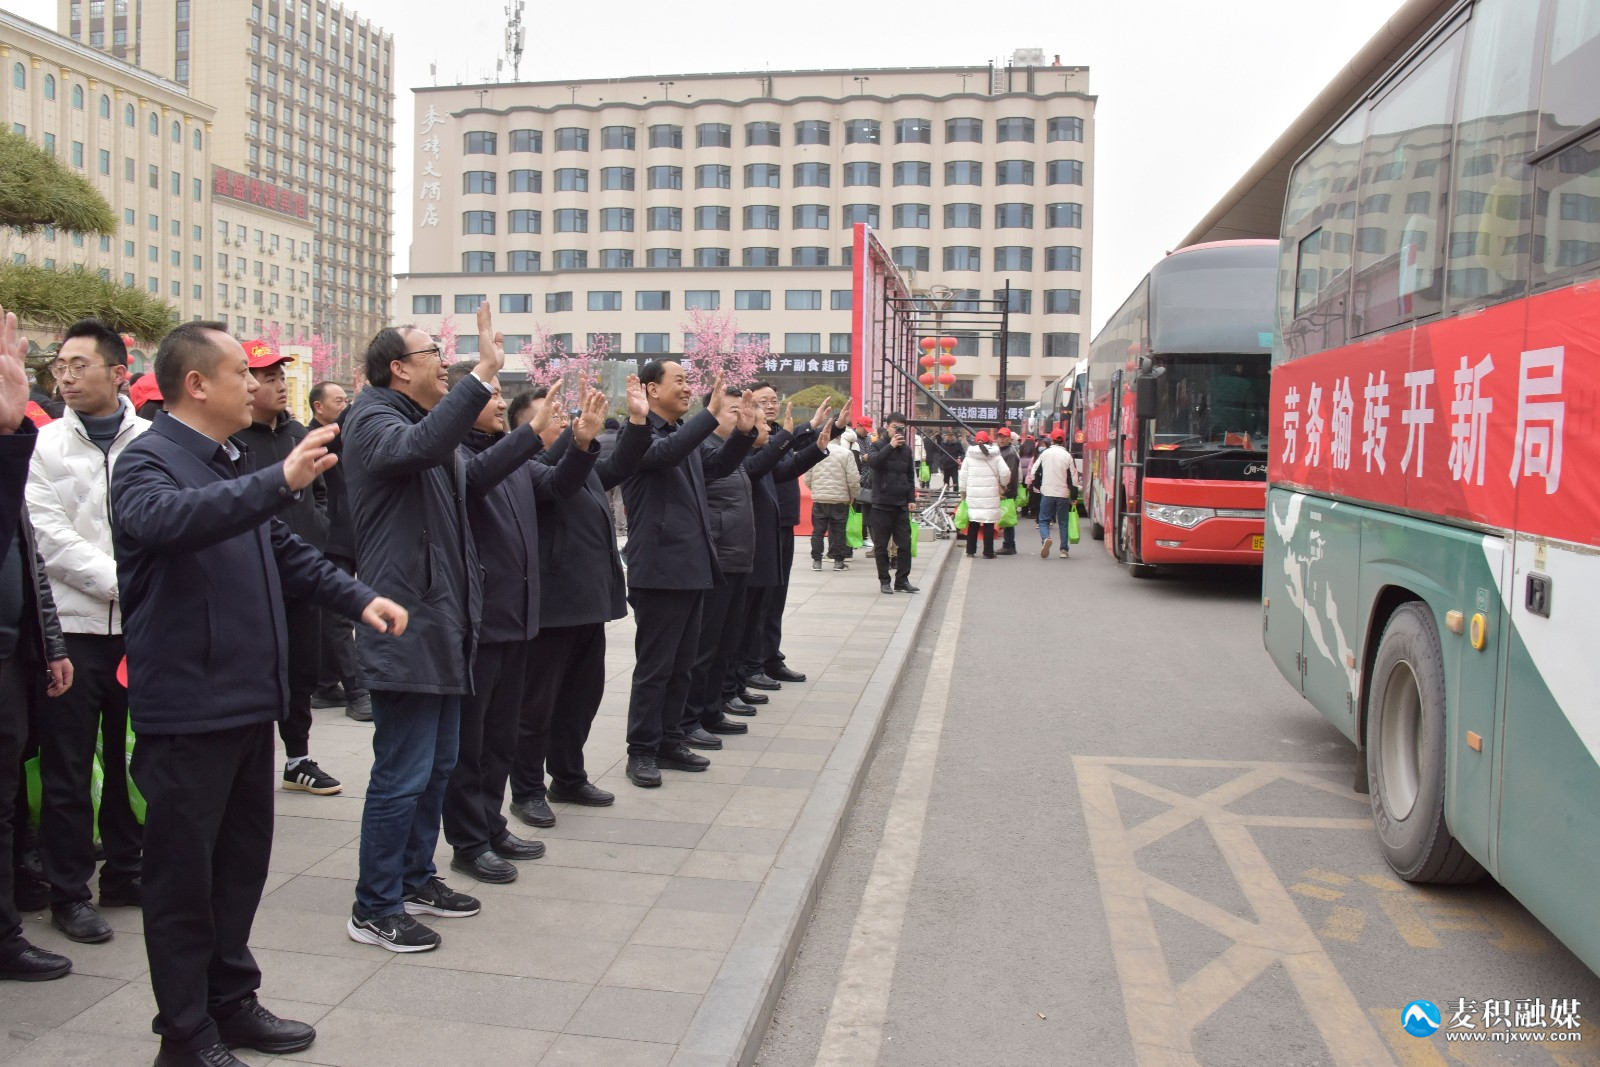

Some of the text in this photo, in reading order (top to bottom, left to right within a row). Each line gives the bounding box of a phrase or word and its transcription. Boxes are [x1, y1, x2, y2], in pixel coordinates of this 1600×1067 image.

[765, 358, 850, 372] 特产副食超市
[1281, 345, 1565, 496] 劳务输转开新局
